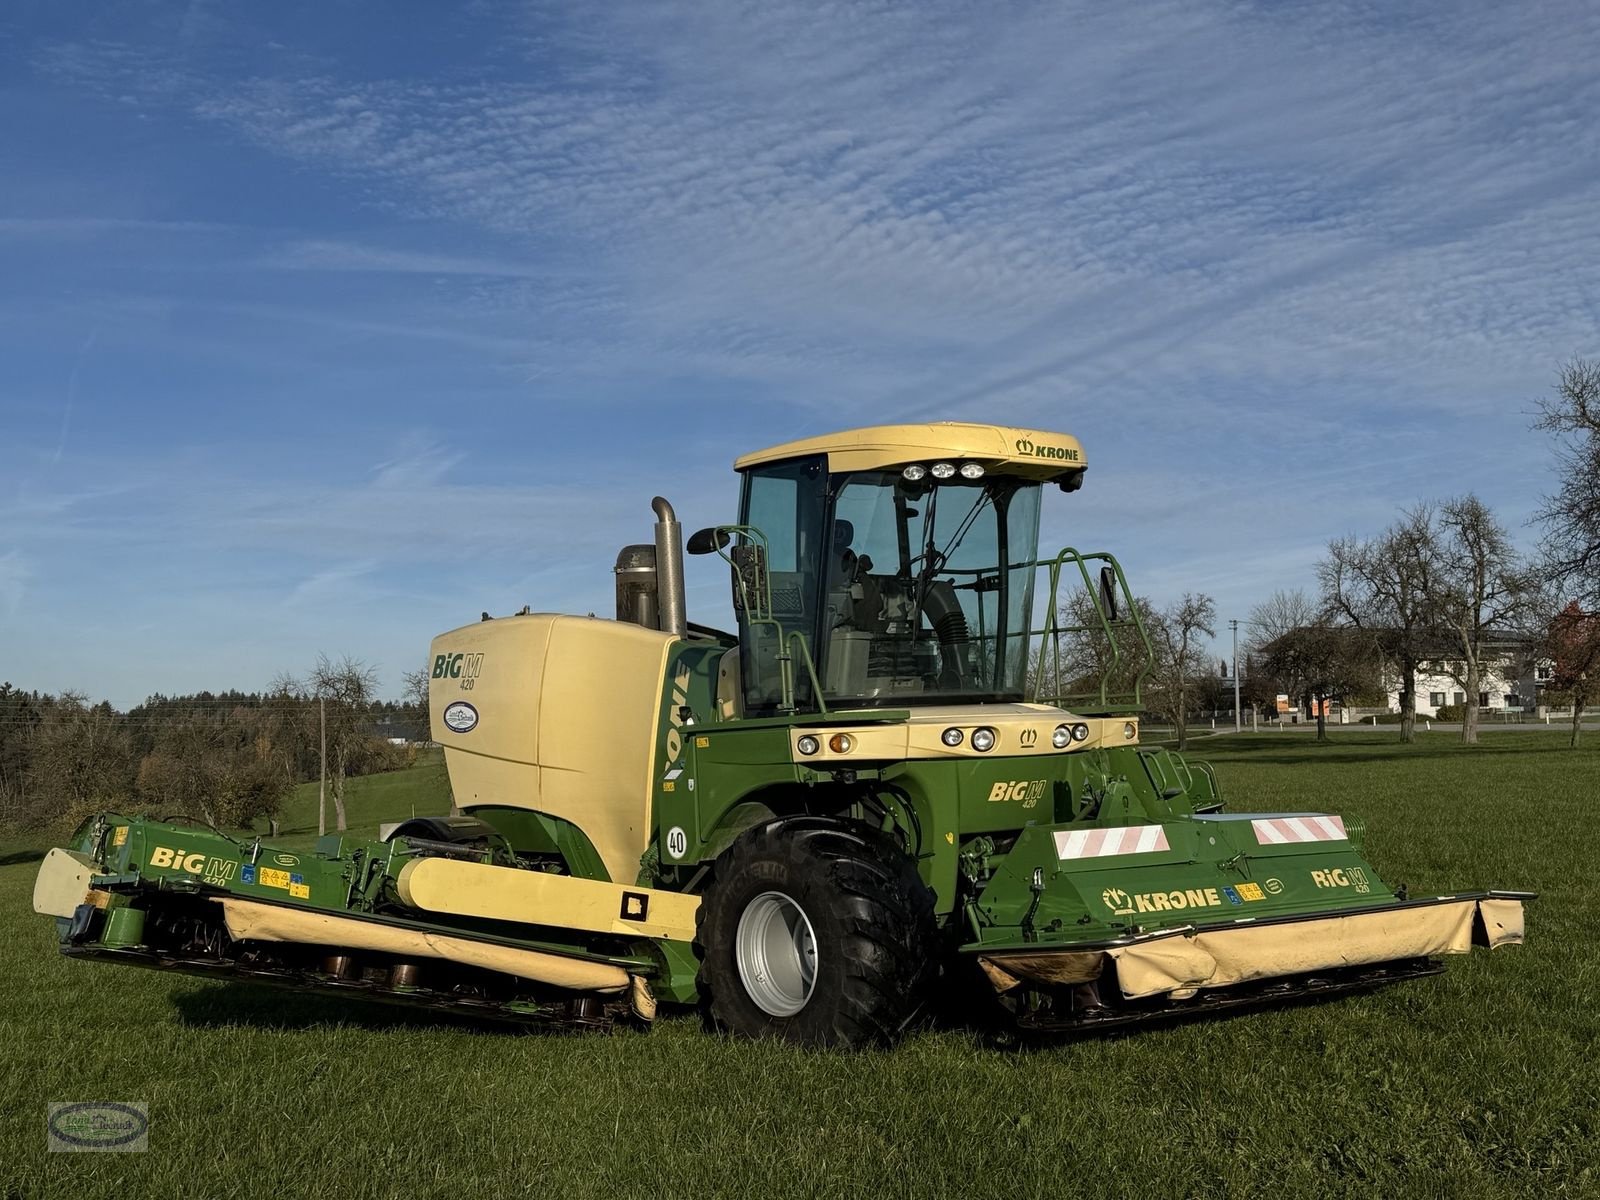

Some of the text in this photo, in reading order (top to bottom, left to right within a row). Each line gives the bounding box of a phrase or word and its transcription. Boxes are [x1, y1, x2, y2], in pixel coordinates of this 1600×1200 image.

[1036, 446, 1079, 461] KRONE
[460, 679, 475, 691] 420
[1022, 799, 1037, 808] 420
[669, 832, 684, 853] 40
[203, 876, 226, 888] 420
[1355, 884, 1370, 893] 420
[1134, 888, 1222, 913] KRONE
